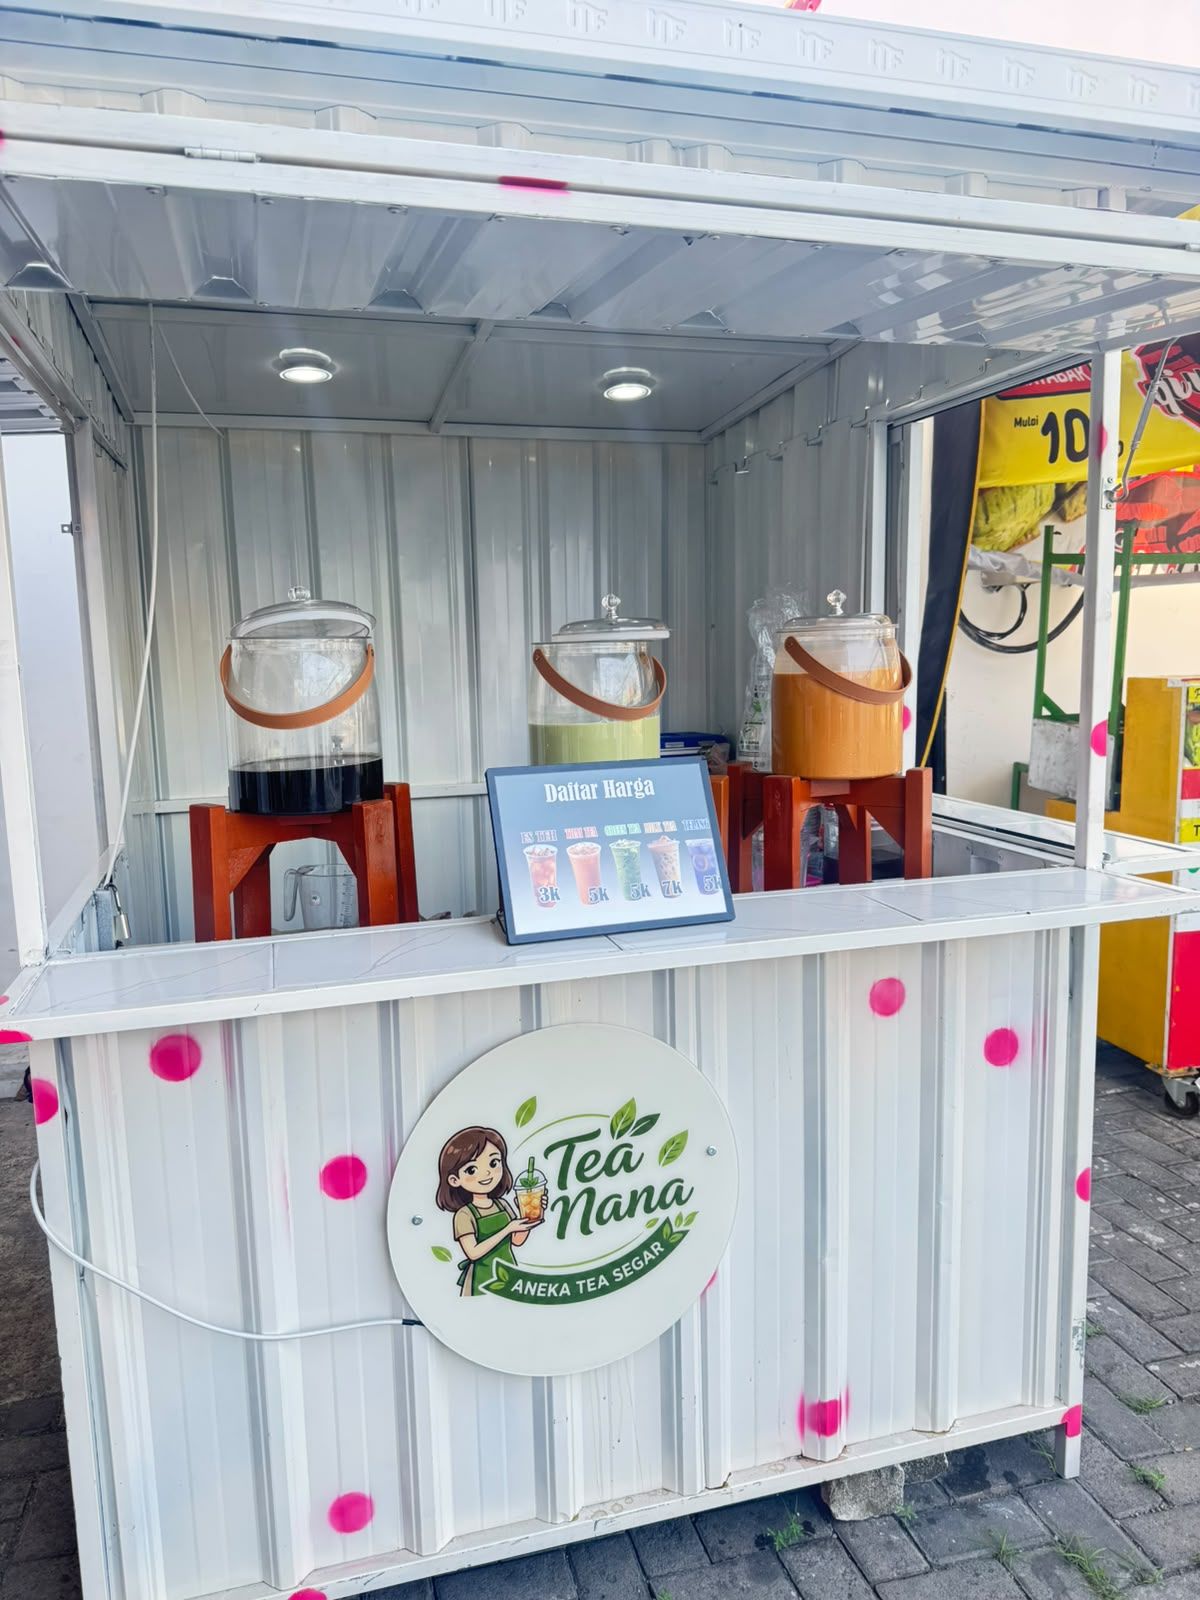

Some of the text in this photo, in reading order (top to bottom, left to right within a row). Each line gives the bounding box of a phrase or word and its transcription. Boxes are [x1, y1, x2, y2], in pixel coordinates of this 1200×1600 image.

[1014, 415, 1038, 428] Mulai
[544, 777, 656, 804] Daftar Harga
[538, 886, 560, 903] 3k
[588, 887, 610, 903] 5k
[629, 883, 651, 900] 5k
[661, 880, 683, 897] 7k
[543, 1128, 644, 1190] Tea
[550, 1177, 694, 1240] Nana
[511, 1241, 665, 1298] ANEKA TEA SEGAR
